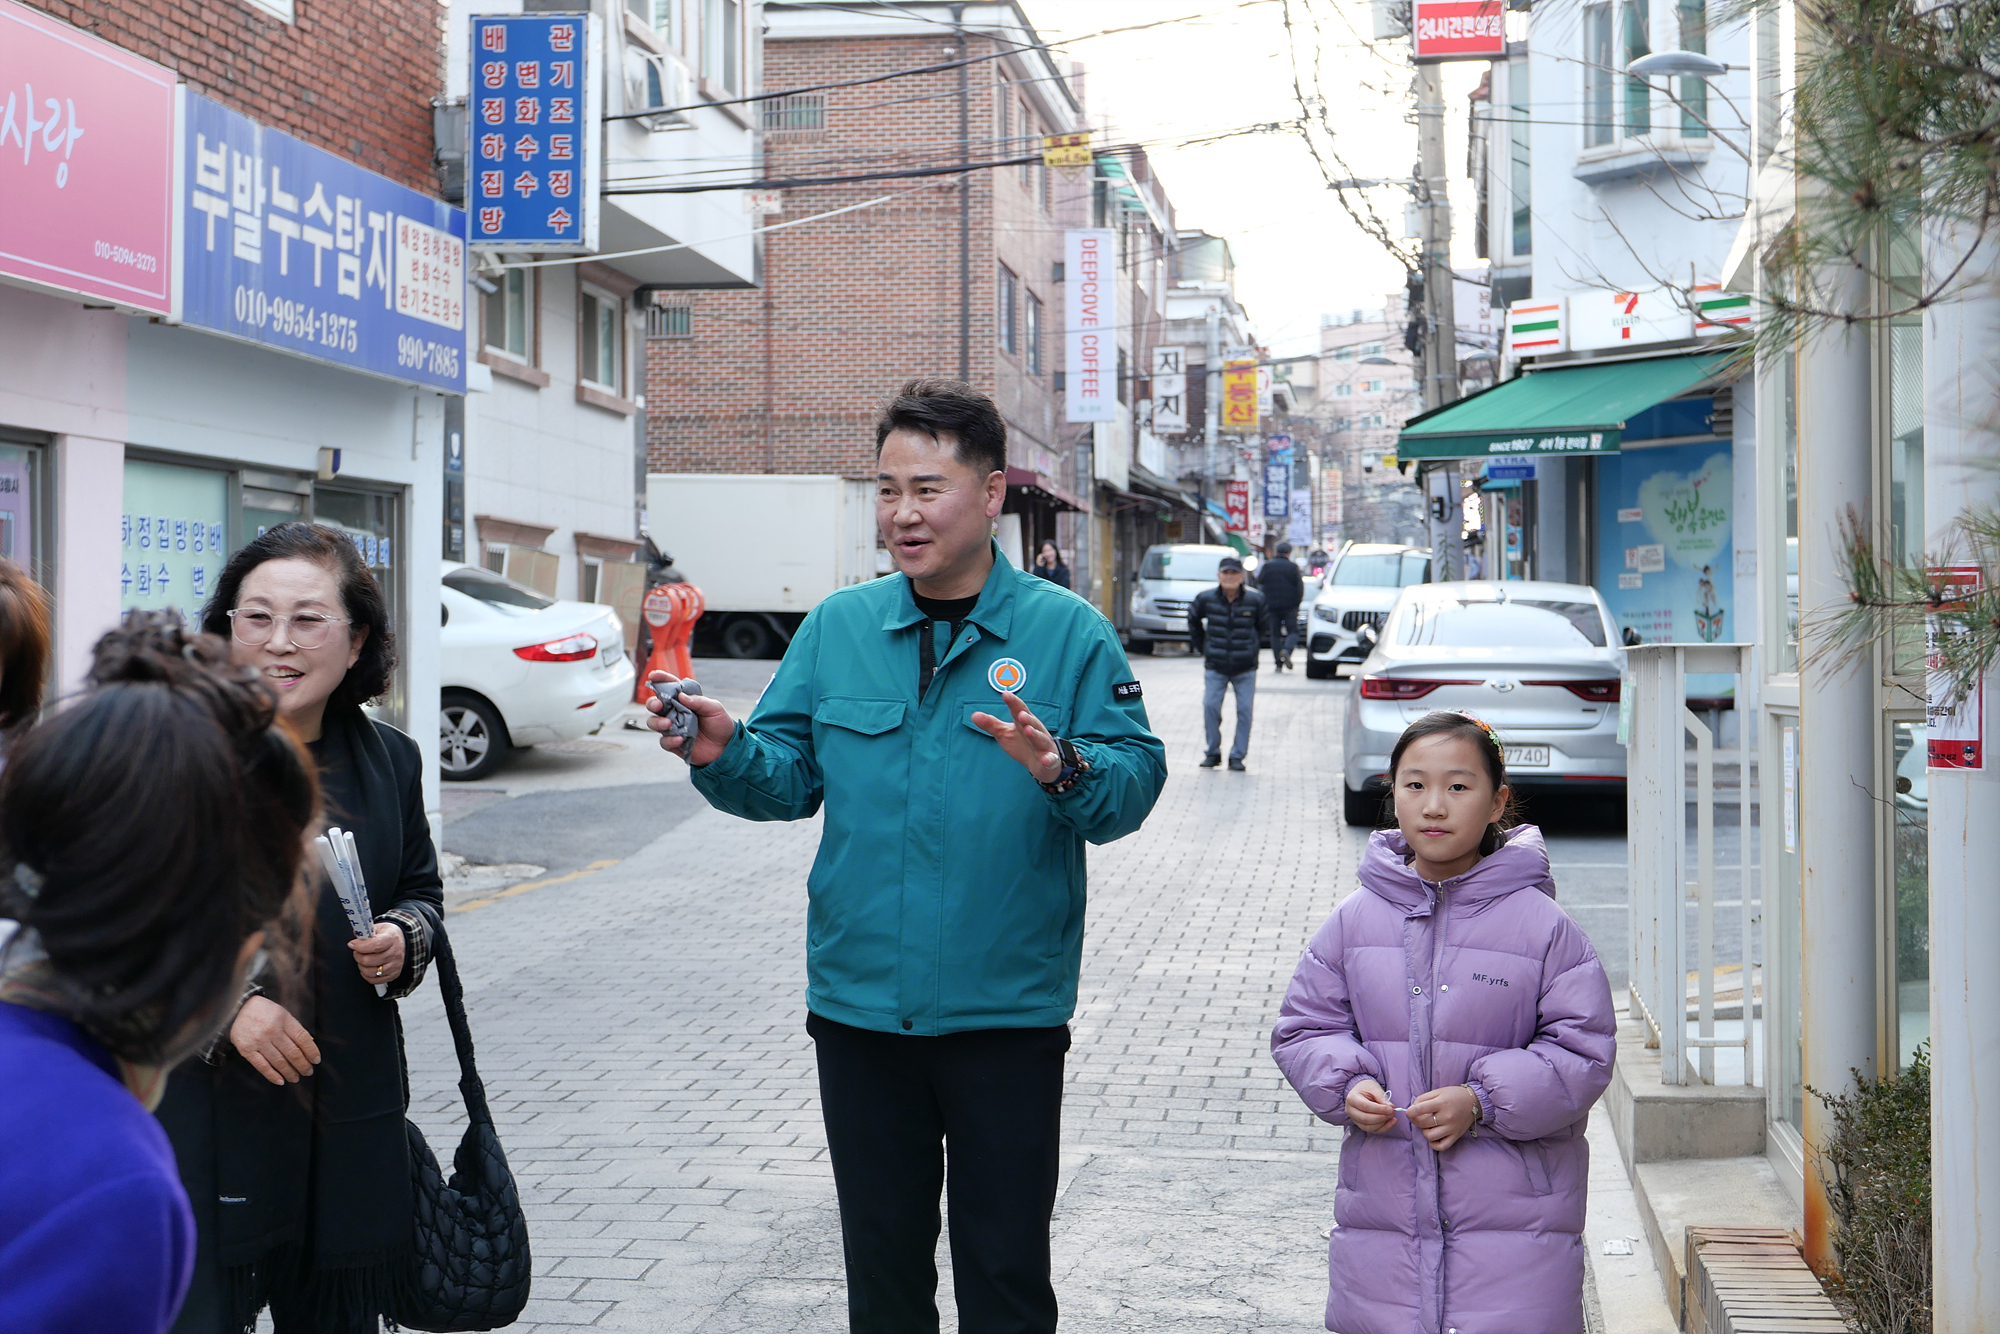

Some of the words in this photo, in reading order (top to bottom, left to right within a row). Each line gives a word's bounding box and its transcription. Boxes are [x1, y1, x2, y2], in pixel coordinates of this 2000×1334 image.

[1419, 15, 1500, 40] 24시간편의점
[482, 60, 573, 88] 양변기
[481, 97, 574, 125] 정화조
[0, 82, 85, 189] 사랑
[481, 133, 574, 161] 하수도
[480, 170, 572, 198] 집수정
[192, 131, 394, 310] 부발누수탐지
[95, 239, 157, 273] 010-5094-3273
[1080, 238, 1099, 327] DEEPCOVE
[234, 284, 358, 353] 010-9954-1375
[398, 333, 459, 379] 990-7885
[1081, 334, 1100, 399] COFFEE
[1226, 361, 1256, 422] 부동산
[1505, 747, 1543, 763] 7740
[1472, 972, 1509, 988] MF.yrfs
